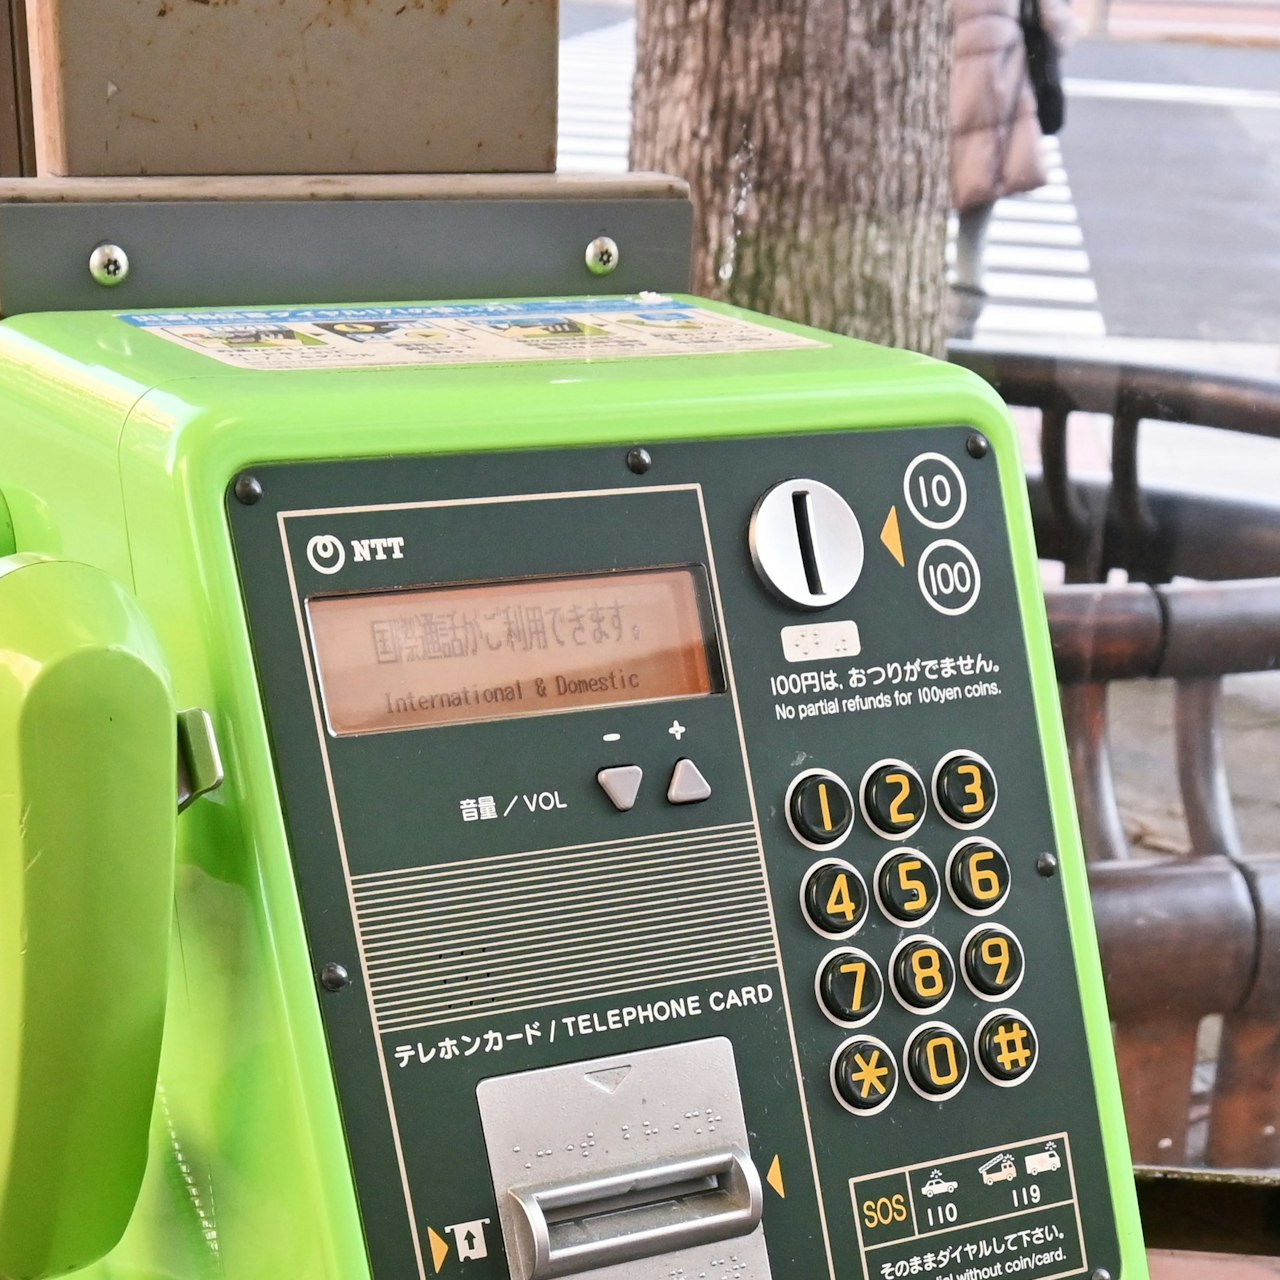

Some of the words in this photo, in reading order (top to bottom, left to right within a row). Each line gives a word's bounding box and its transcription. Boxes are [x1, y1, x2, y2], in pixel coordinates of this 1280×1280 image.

[919, 474, 951, 508] 10
[351, 536, 404, 562] NTT
[929, 561, 971, 596] 100
[385, 680, 523, 714] International
[535, 677, 549, 697] &
[556, 669, 640, 696] Domestic
[775, 703, 796, 720] No
[799, 697, 839, 720] partial
[842, 694, 892, 712] refunds
[894, 690, 913, 706] for
[918, 685, 962, 704] 100yen
[964, 681, 1002, 698] coins.
[460, 795, 498, 822] 音量
[523, 790, 568, 812] VOL
[818, 783, 833, 831] 1
[885, 773, 915, 823] 2
[957, 764, 985, 813] 3
[826, 873, 856, 921] 4
[898, 860, 928, 911] 5
[969, 851, 1000, 899] 6
[840, 962, 866, 1011] 7
[911, 948, 944, 997] 8
[981, 937, 1010, 985] 9
[394, 1019, 543, 1068] テレホンカード
[561, 994, 702, 1038] TELEPHONE
[708, 983, 773, 1012] CARD
[926, 1036, 959, 1086] 0
[993, 1022, 1032, 1071] #
[862, 1193, 908, 1229] SOS
[927, 1203, 959, 1227] 110
[1012, 1184, 1042, 1208] 119
[879, 1224, 1066, 1280] そのままダイヤルして下さい。
[1004, 1248, 1067, 1274] coin/card.
